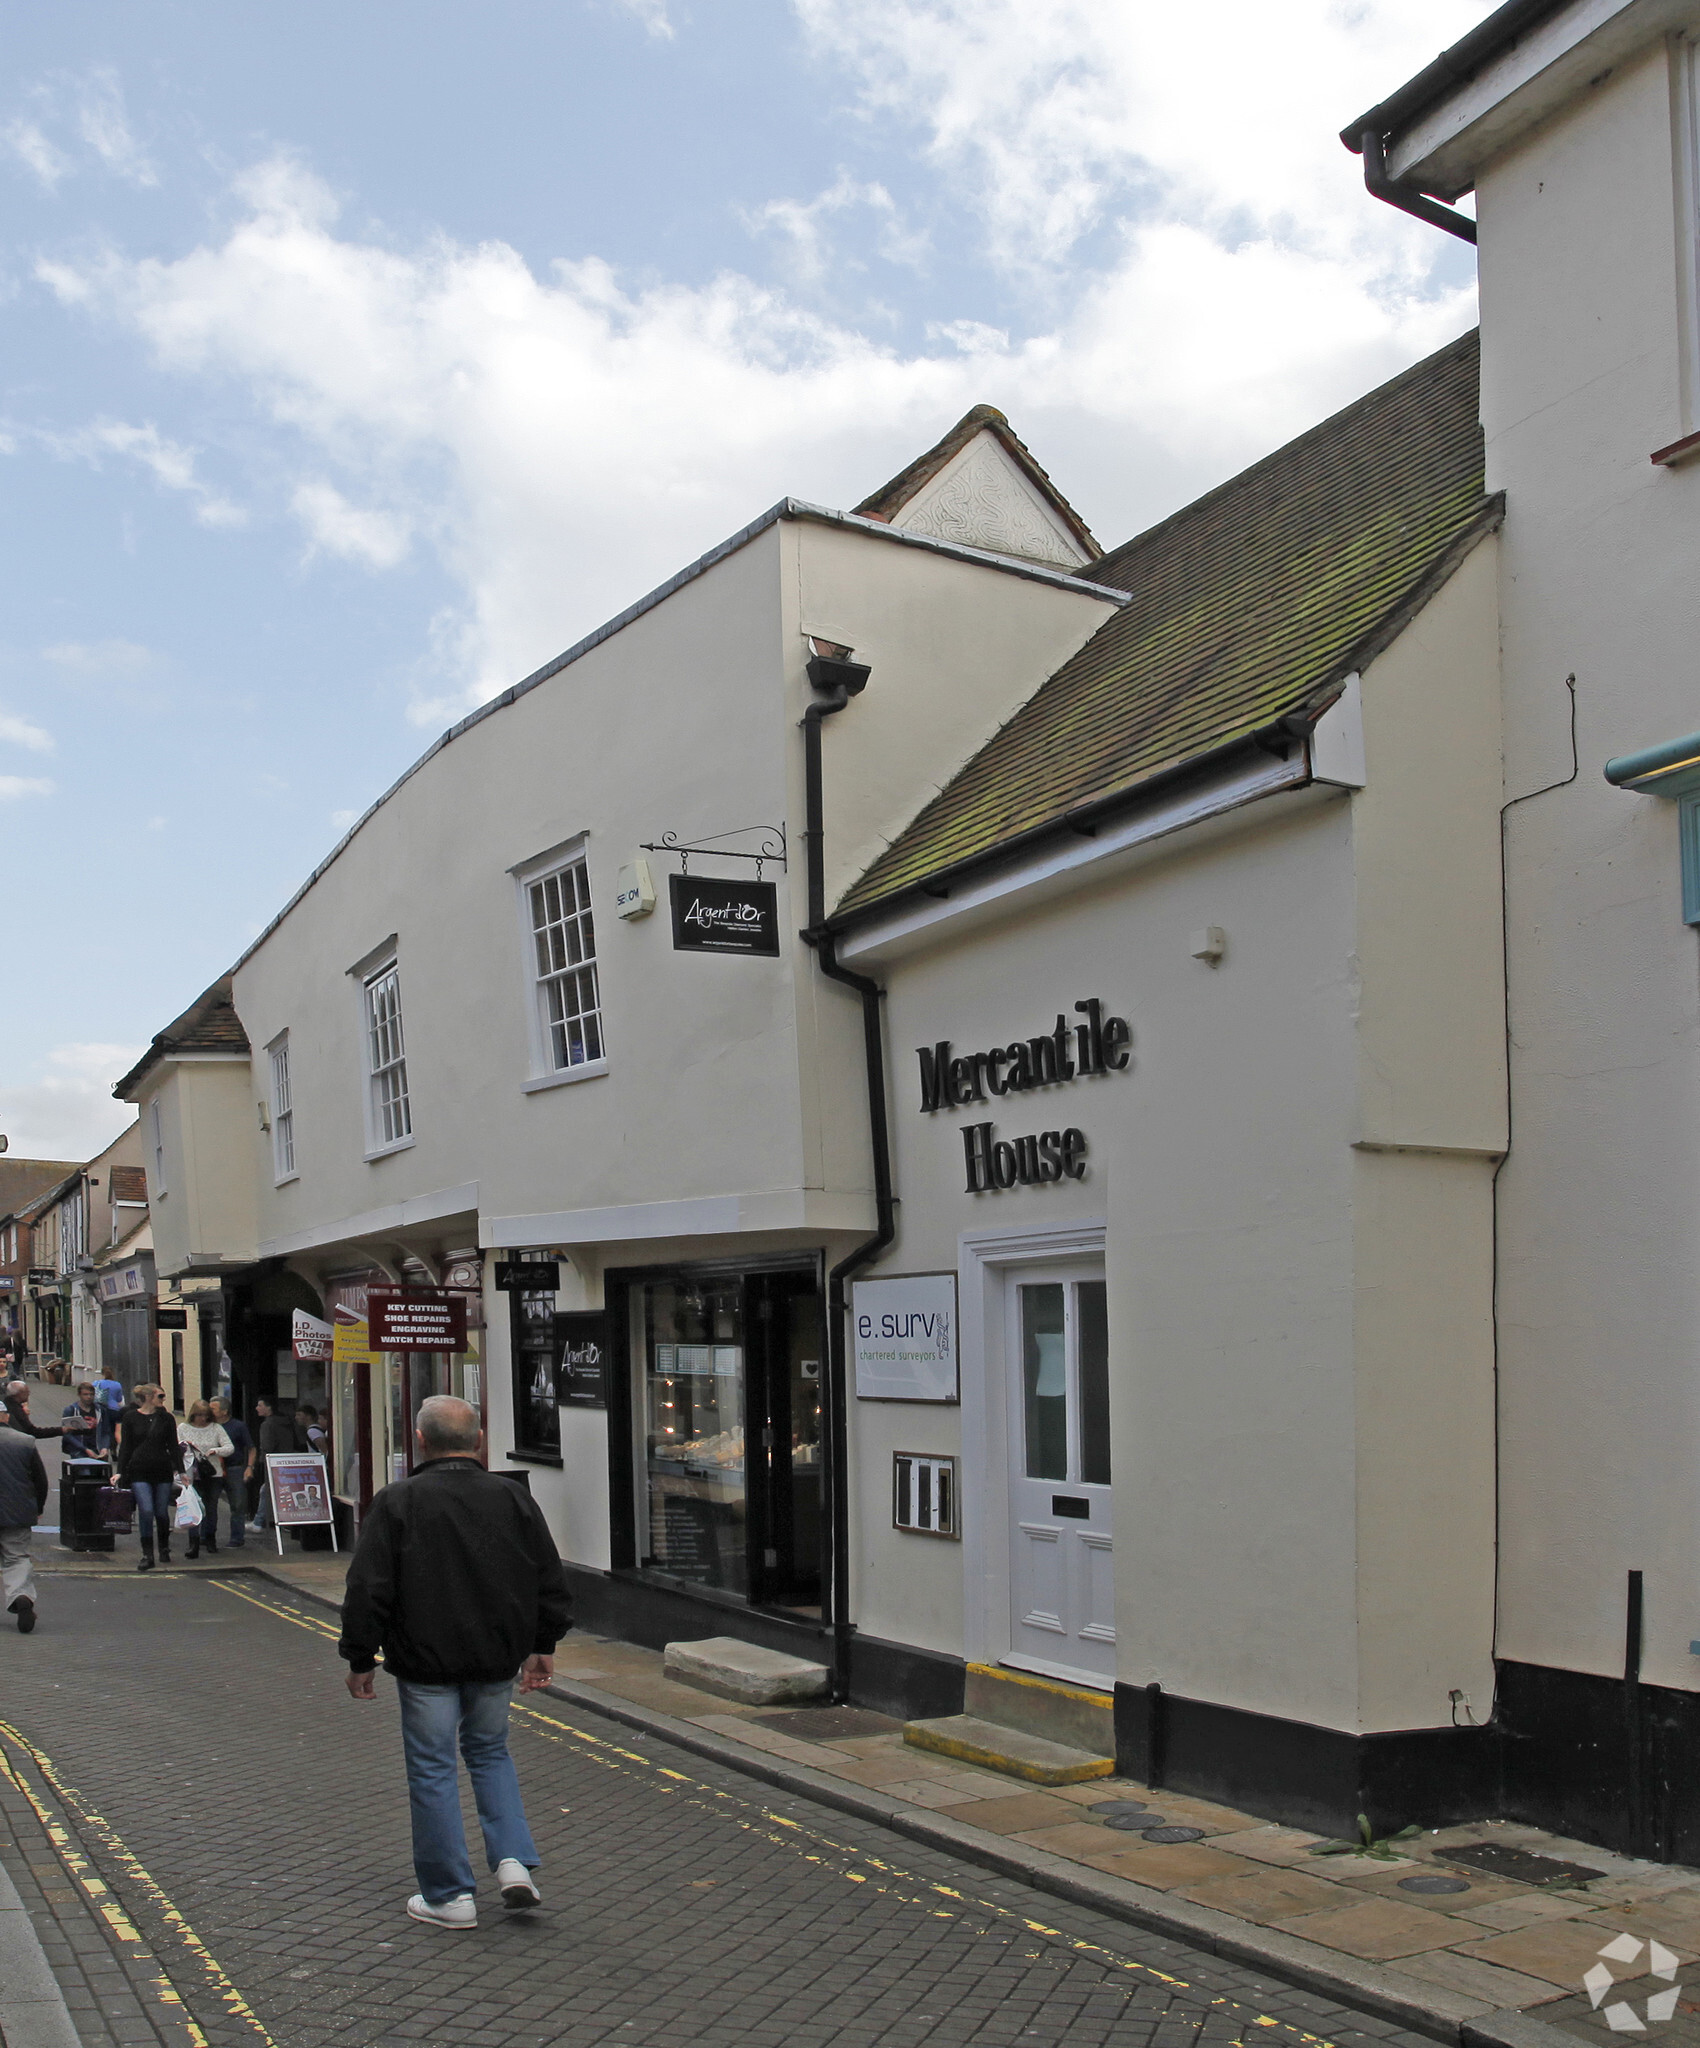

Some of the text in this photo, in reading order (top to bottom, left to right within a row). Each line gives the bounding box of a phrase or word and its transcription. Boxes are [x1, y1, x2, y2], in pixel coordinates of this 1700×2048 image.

[684, 898, 738, 929] Argent
[915, 998, 1130, 1113] Mercantile
[959, 1121, 1087, 1193] House
[408, 1304, 448, 1312] CUTTING
[384, 1314, 452, 1323] SHOE REPAIRS
[295, 1321, 313, 1330] I.D.
[391, 1325, 446, 1333] ENGRAVING
[858, 1313, 936, 1338] e.surv
[295, 1330, 332, 1339] Photos
[416, 1337, 456, 1345] REPAIRS
[860, 1349, 936, 1363] chartered surveyors
